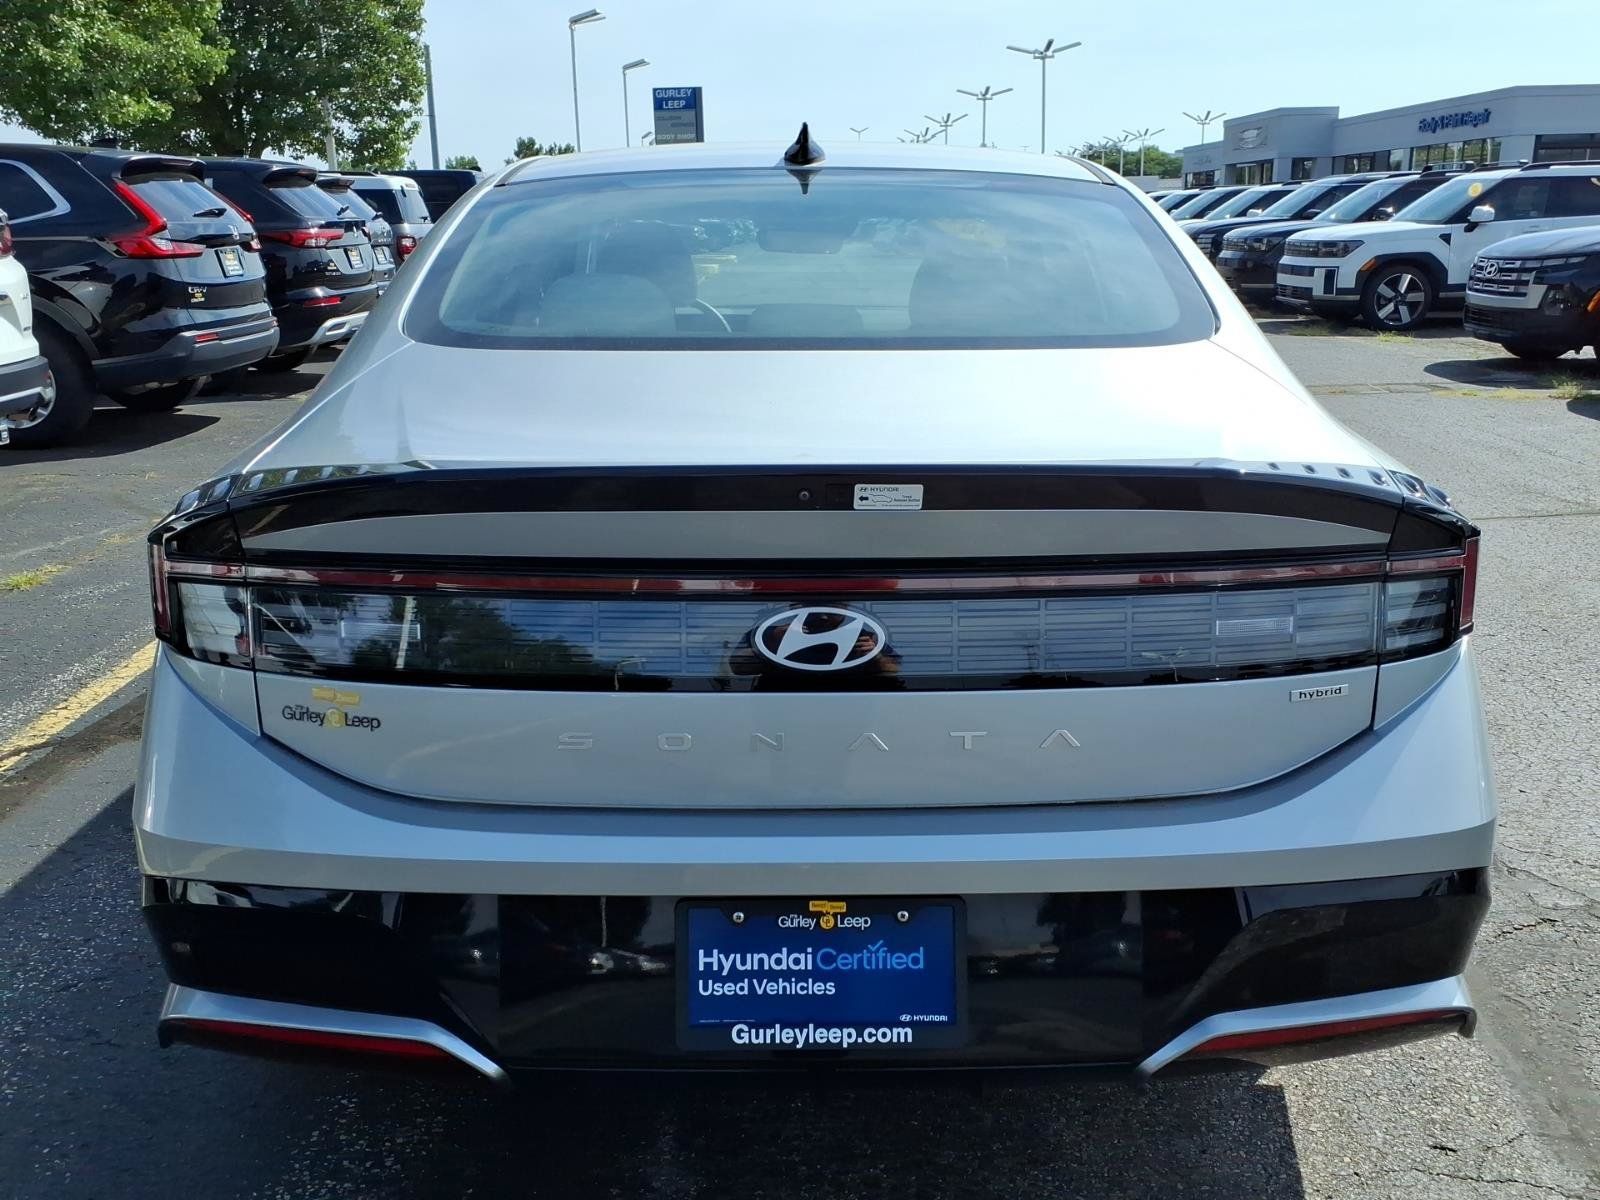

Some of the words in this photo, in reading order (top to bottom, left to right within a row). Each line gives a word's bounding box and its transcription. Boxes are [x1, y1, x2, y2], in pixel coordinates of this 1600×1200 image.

[655, 88, 692, 98] GURLEY
[662, 99, 686, 109] LEEP
[1298, 686, 1342, 699] hybrid
[344, 712, 382, 732] Leep
[557, 728, 1081, 752] SONATA
[837, 914, 872, 931] Leep
[698, 946, 813, 976] Hyundai
[816, 940, 925, 970] Certified
[698, 977, 749, 996] Used
[752, 977, 837, 996] Vehicles
[913, 1014, 948, 1022] HYUNDAI
[731, 1023, 914, 1049] Gurleyleep.com
